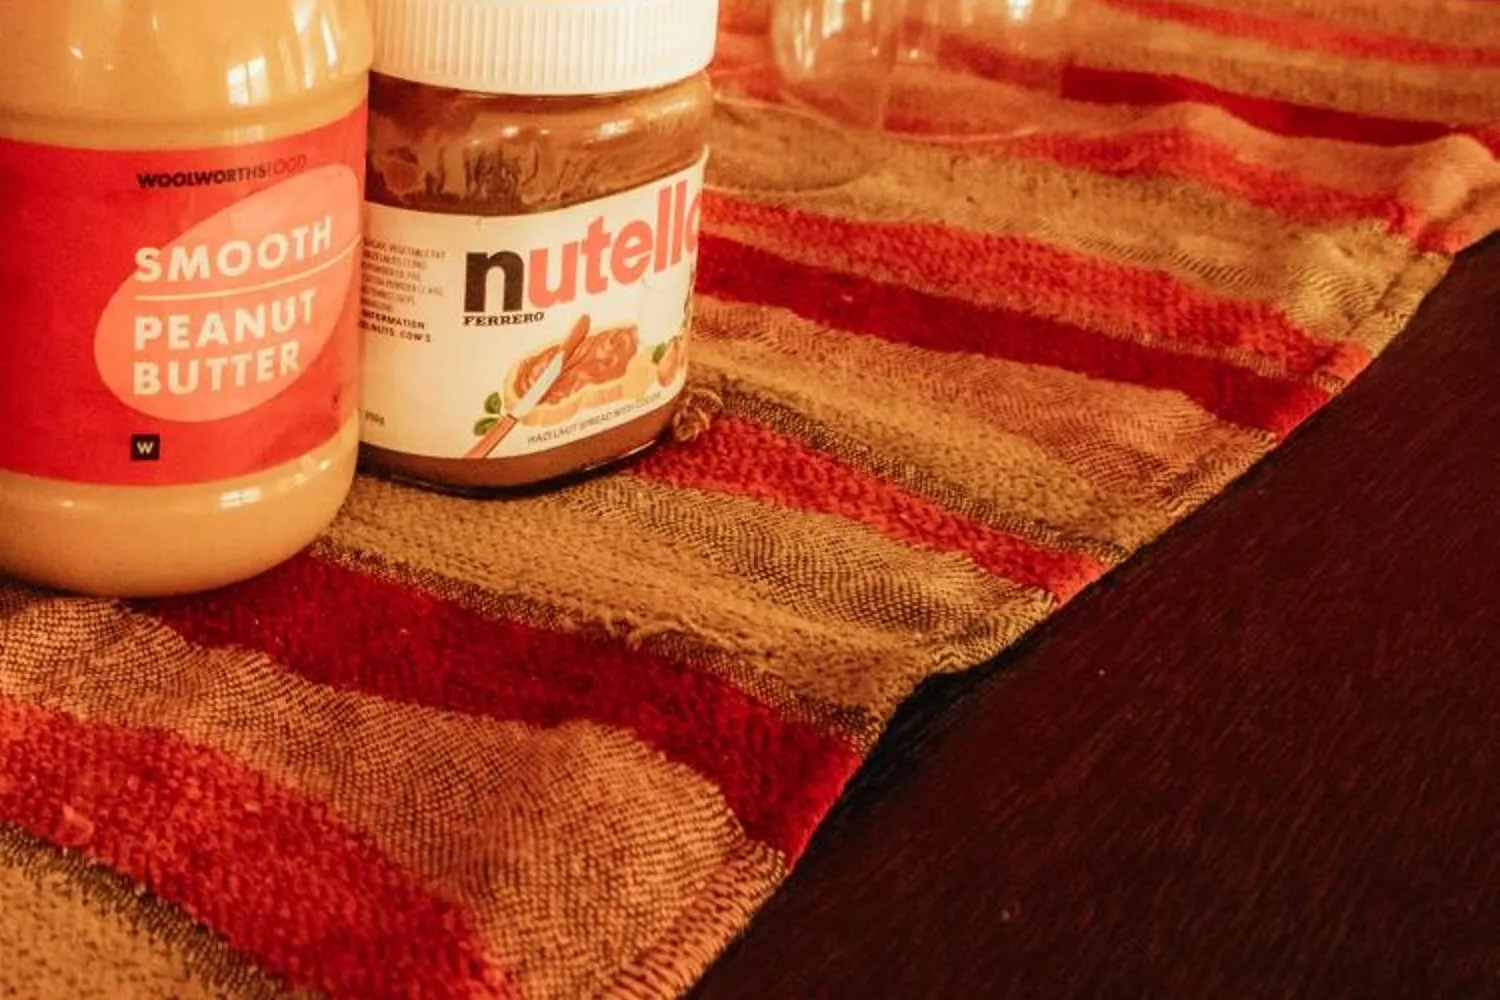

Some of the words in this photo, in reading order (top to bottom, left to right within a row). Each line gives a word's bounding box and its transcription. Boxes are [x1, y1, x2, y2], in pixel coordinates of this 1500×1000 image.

[134, 214, 333, 283] SMOOTH
[134, 289, 318, 351] PEANUT
[463, 312, 545, 327] FERRERO
[132, 340, 302, 396] BUTTER
[136, 440, 155, 456] W
